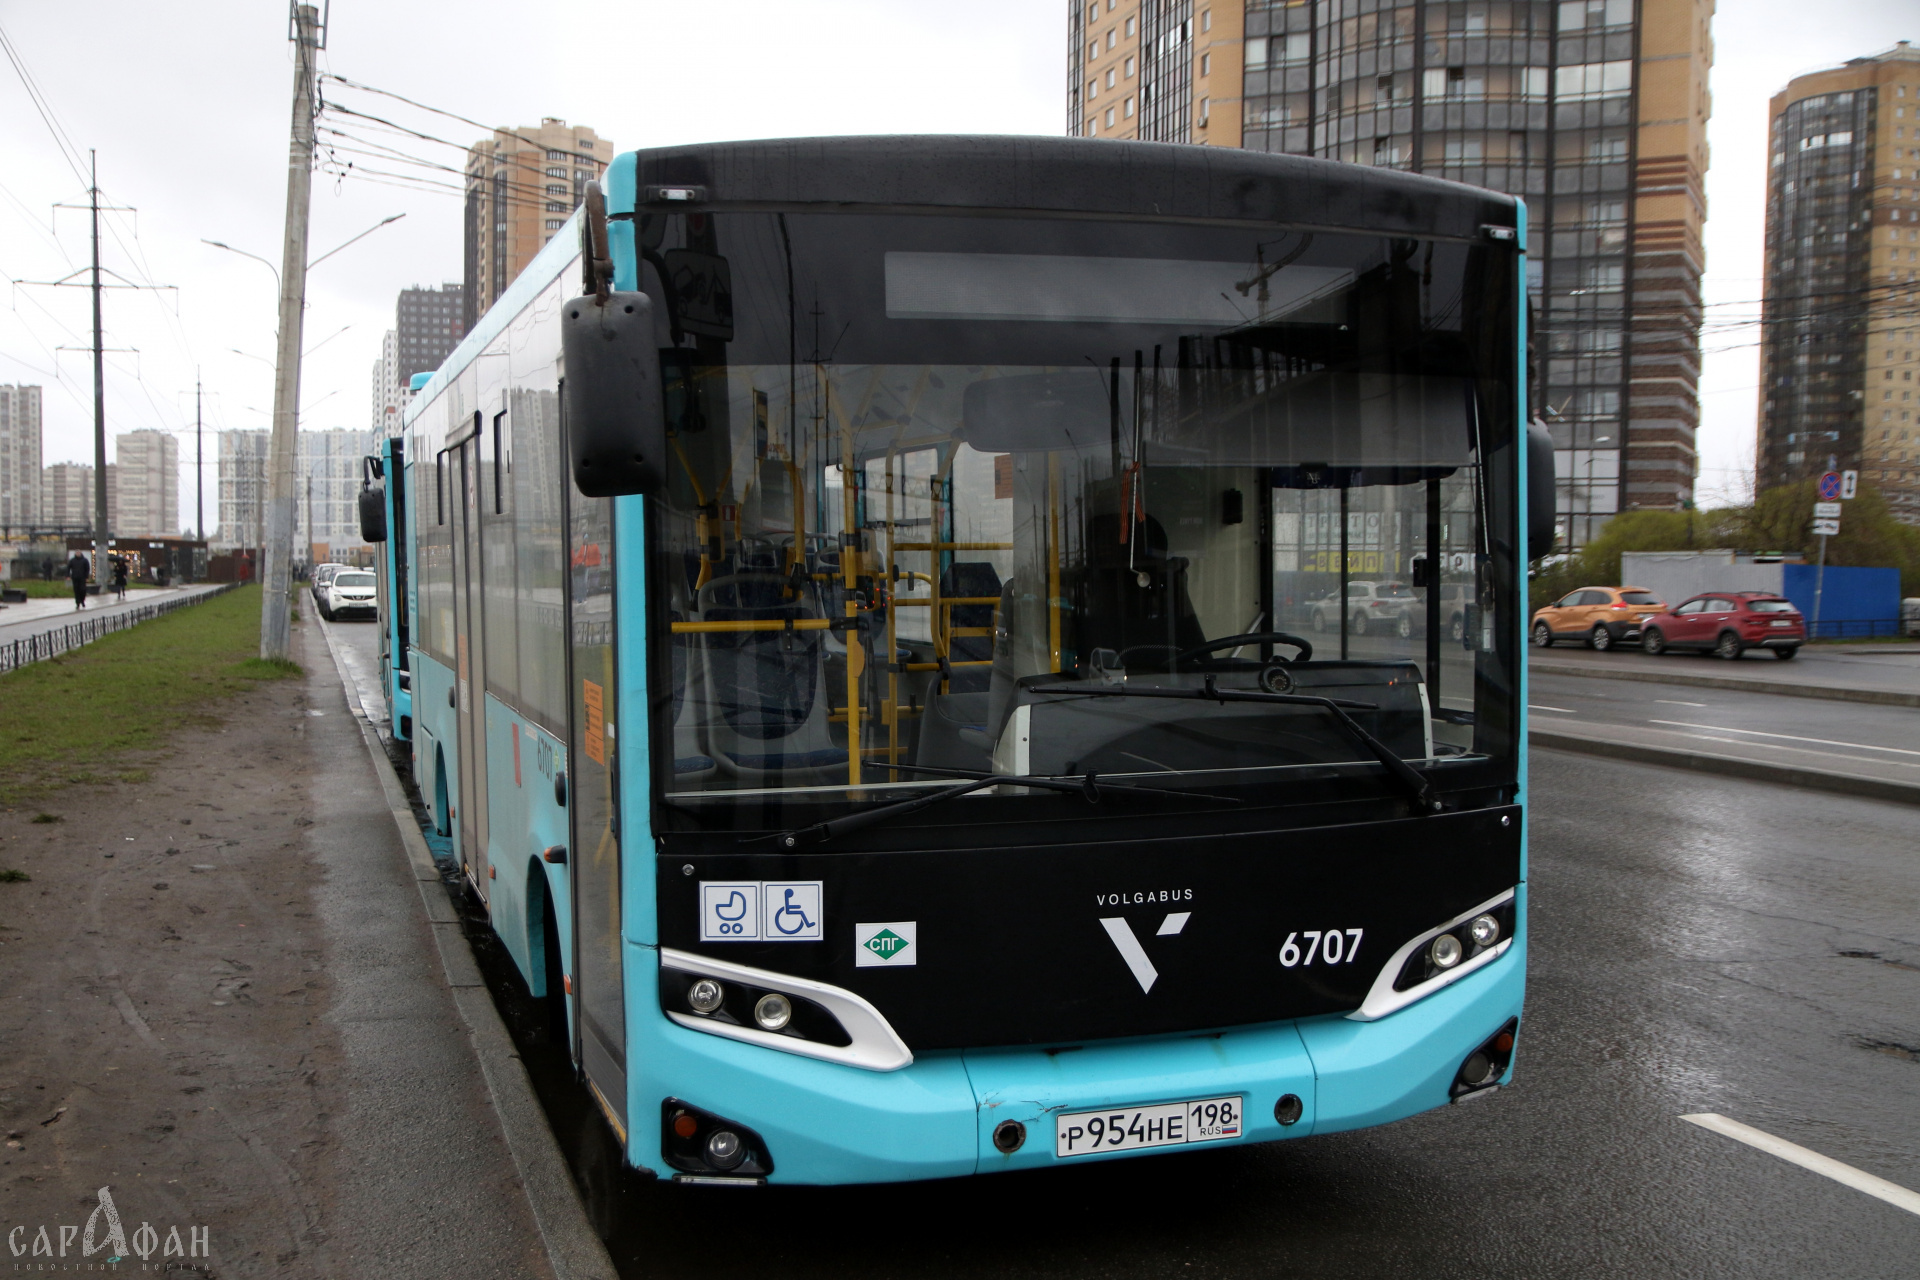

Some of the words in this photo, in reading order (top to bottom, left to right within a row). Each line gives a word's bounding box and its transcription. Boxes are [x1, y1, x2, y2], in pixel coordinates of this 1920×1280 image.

[537, 735, 553, 782] 6707
[1096, 888, 1193, 906] VOLGABUS
[869, 937, 899, 951] СПГ
[1279, 928, 1363, 967] 6707
[1191, 1102, 1233, 1128] 198
[1200, 1126, 1221, 1136] RUS
